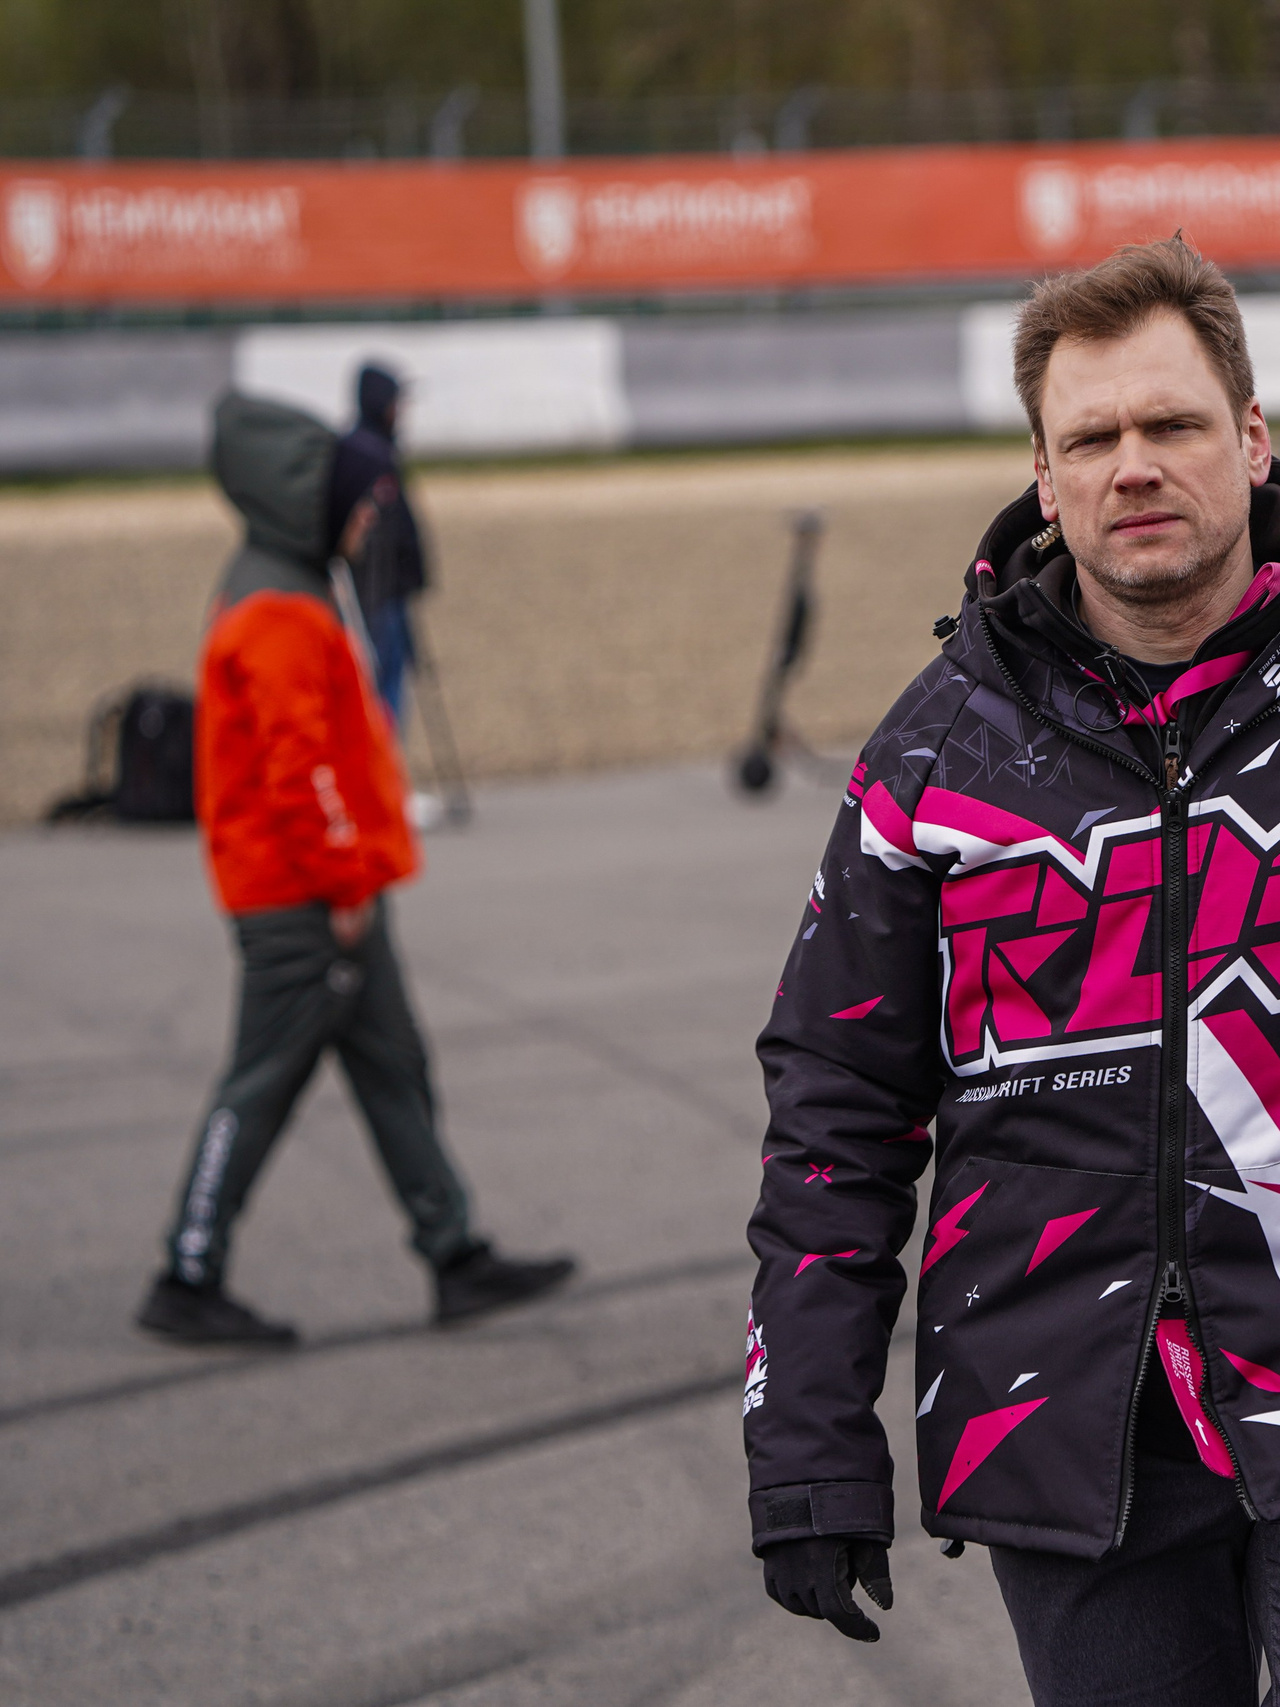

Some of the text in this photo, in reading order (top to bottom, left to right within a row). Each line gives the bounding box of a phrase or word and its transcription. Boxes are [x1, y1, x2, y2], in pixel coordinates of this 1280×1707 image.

[1258, 653, 1277, 676] SERIES
[1052, 1065, 1133, 1091] SERIES
[1165, 1338, 1182, 1380] SERIES
[1172, 1342, 1186, 1379] DRIFT
[1180, 1346, 1198, 1400] RUSSIAN
